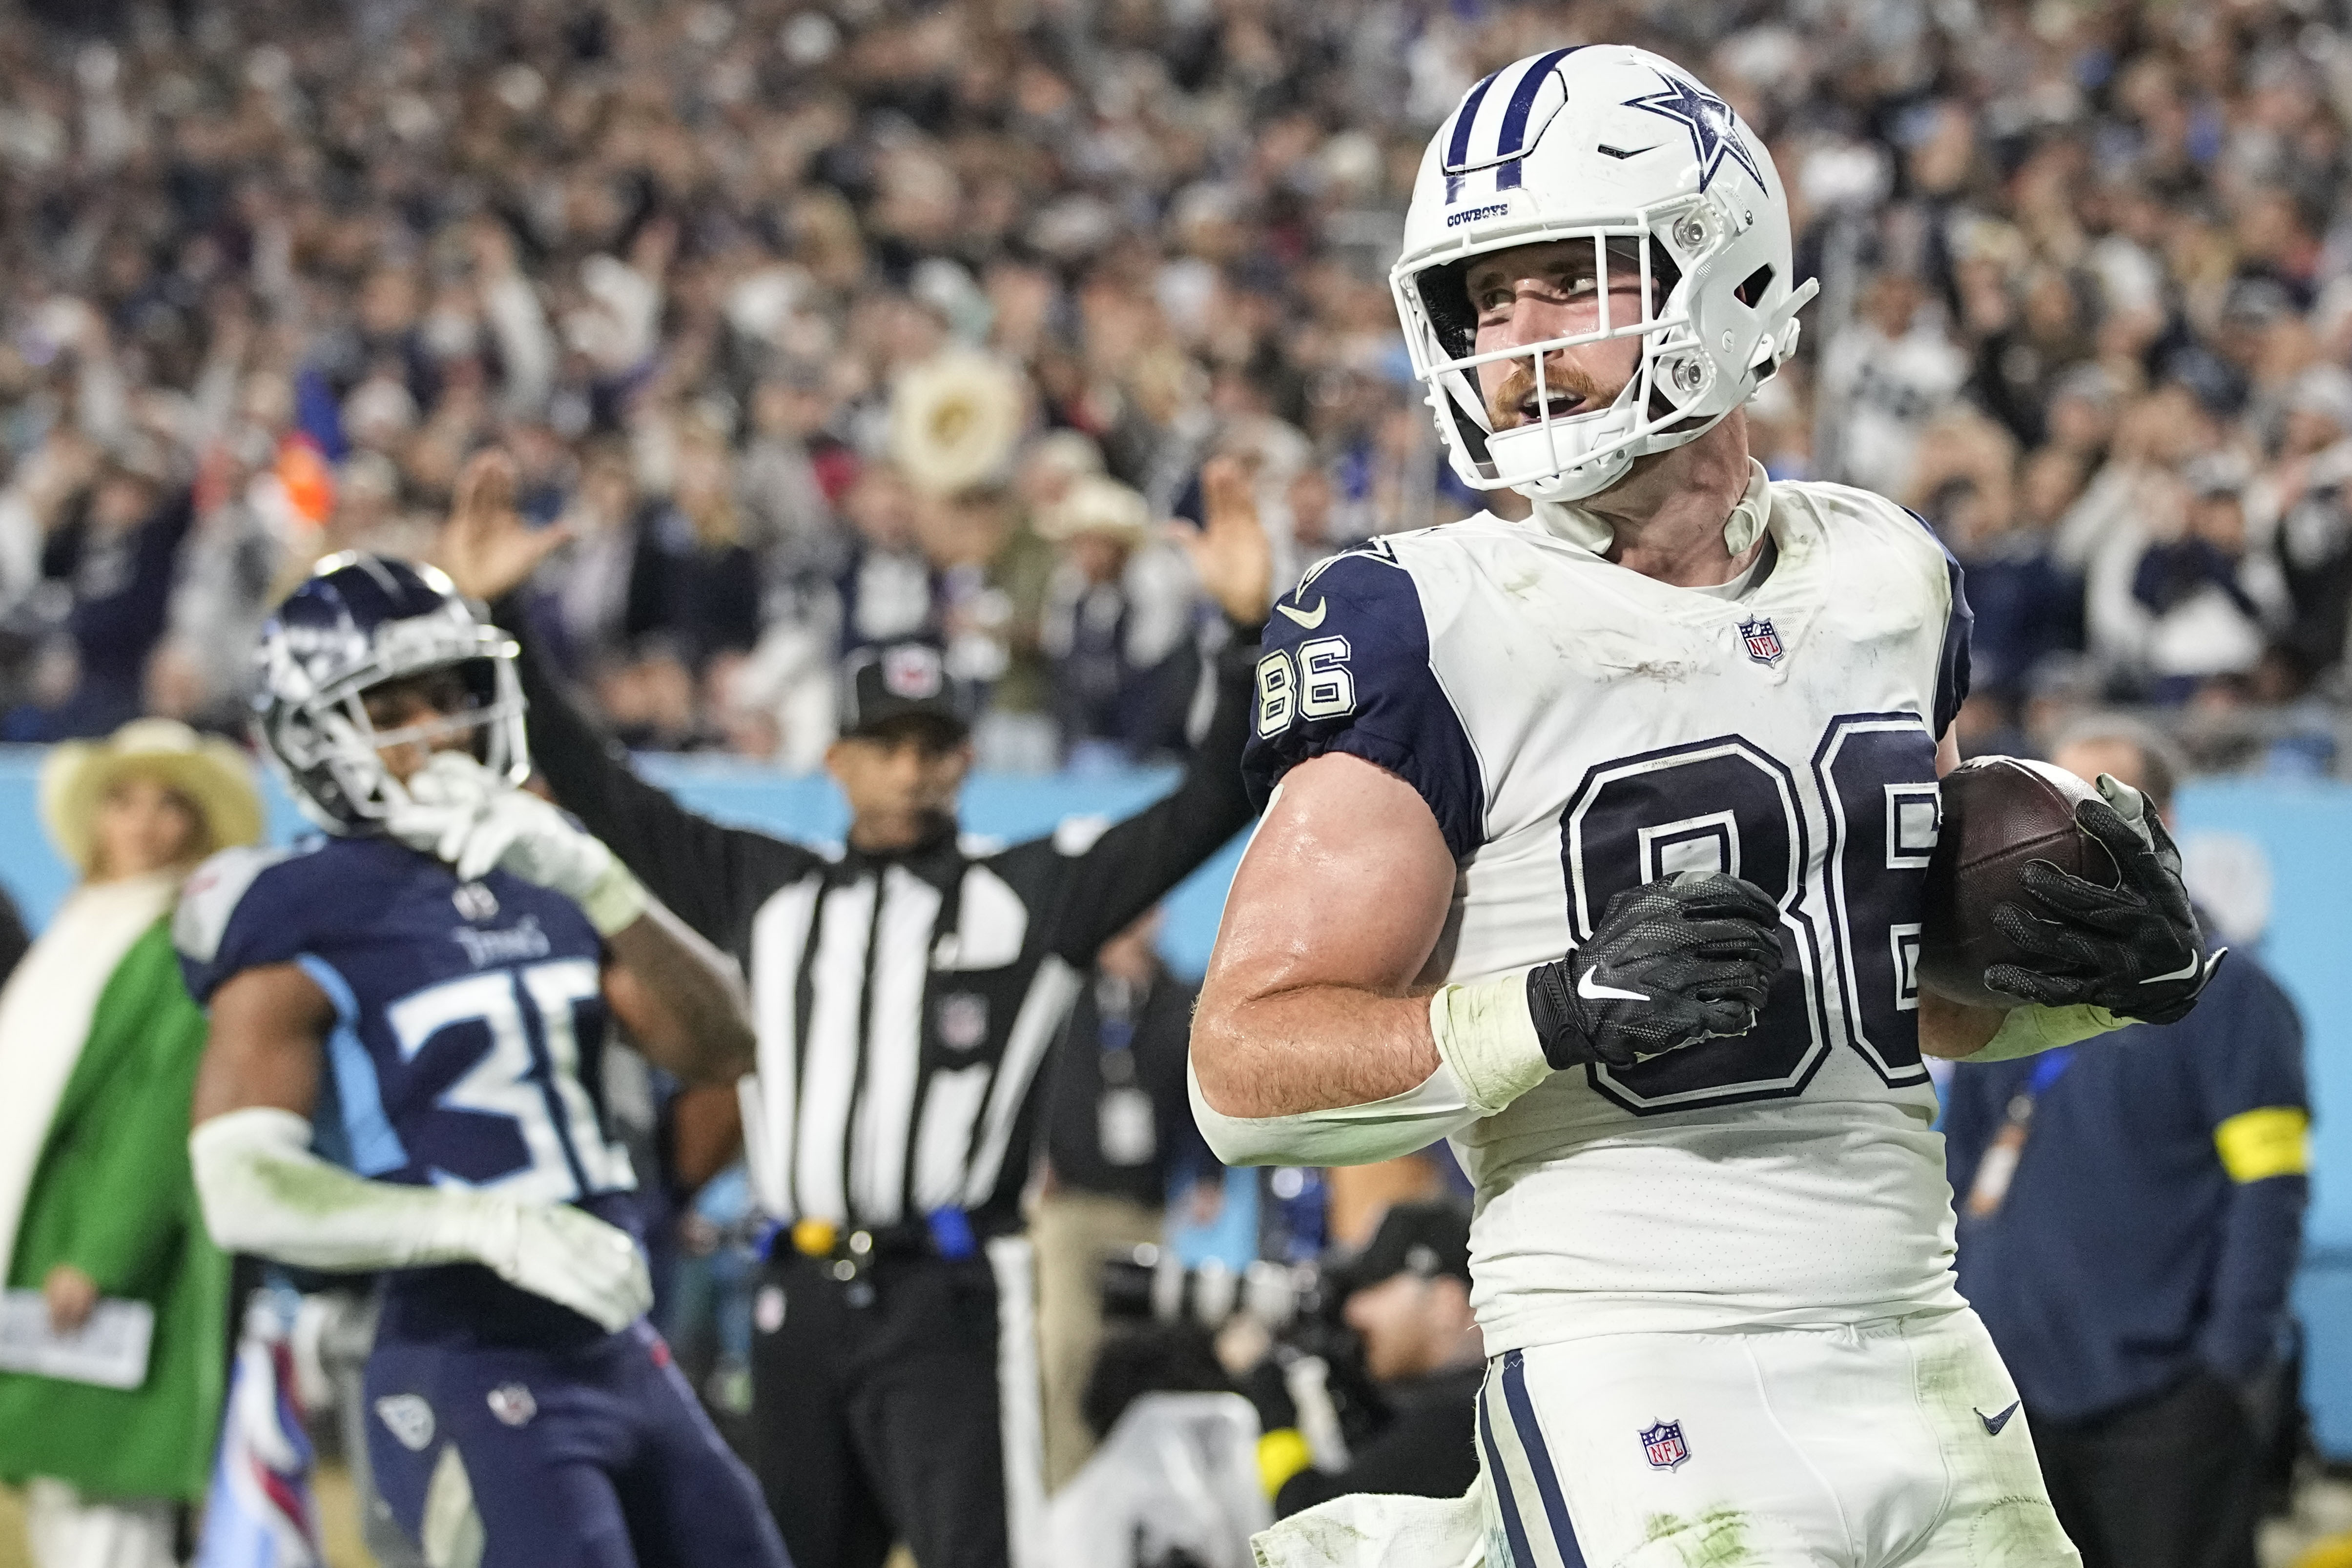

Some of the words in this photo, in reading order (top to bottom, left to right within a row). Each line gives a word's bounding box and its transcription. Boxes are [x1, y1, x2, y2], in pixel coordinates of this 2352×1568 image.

[1447, 204, 1508, 227] COWBOYS
[1748, 636, 1779, 656] NFL
[1256, 634, 1357, 739] 86
[1650, 1440, 1684, 1463] NFL
